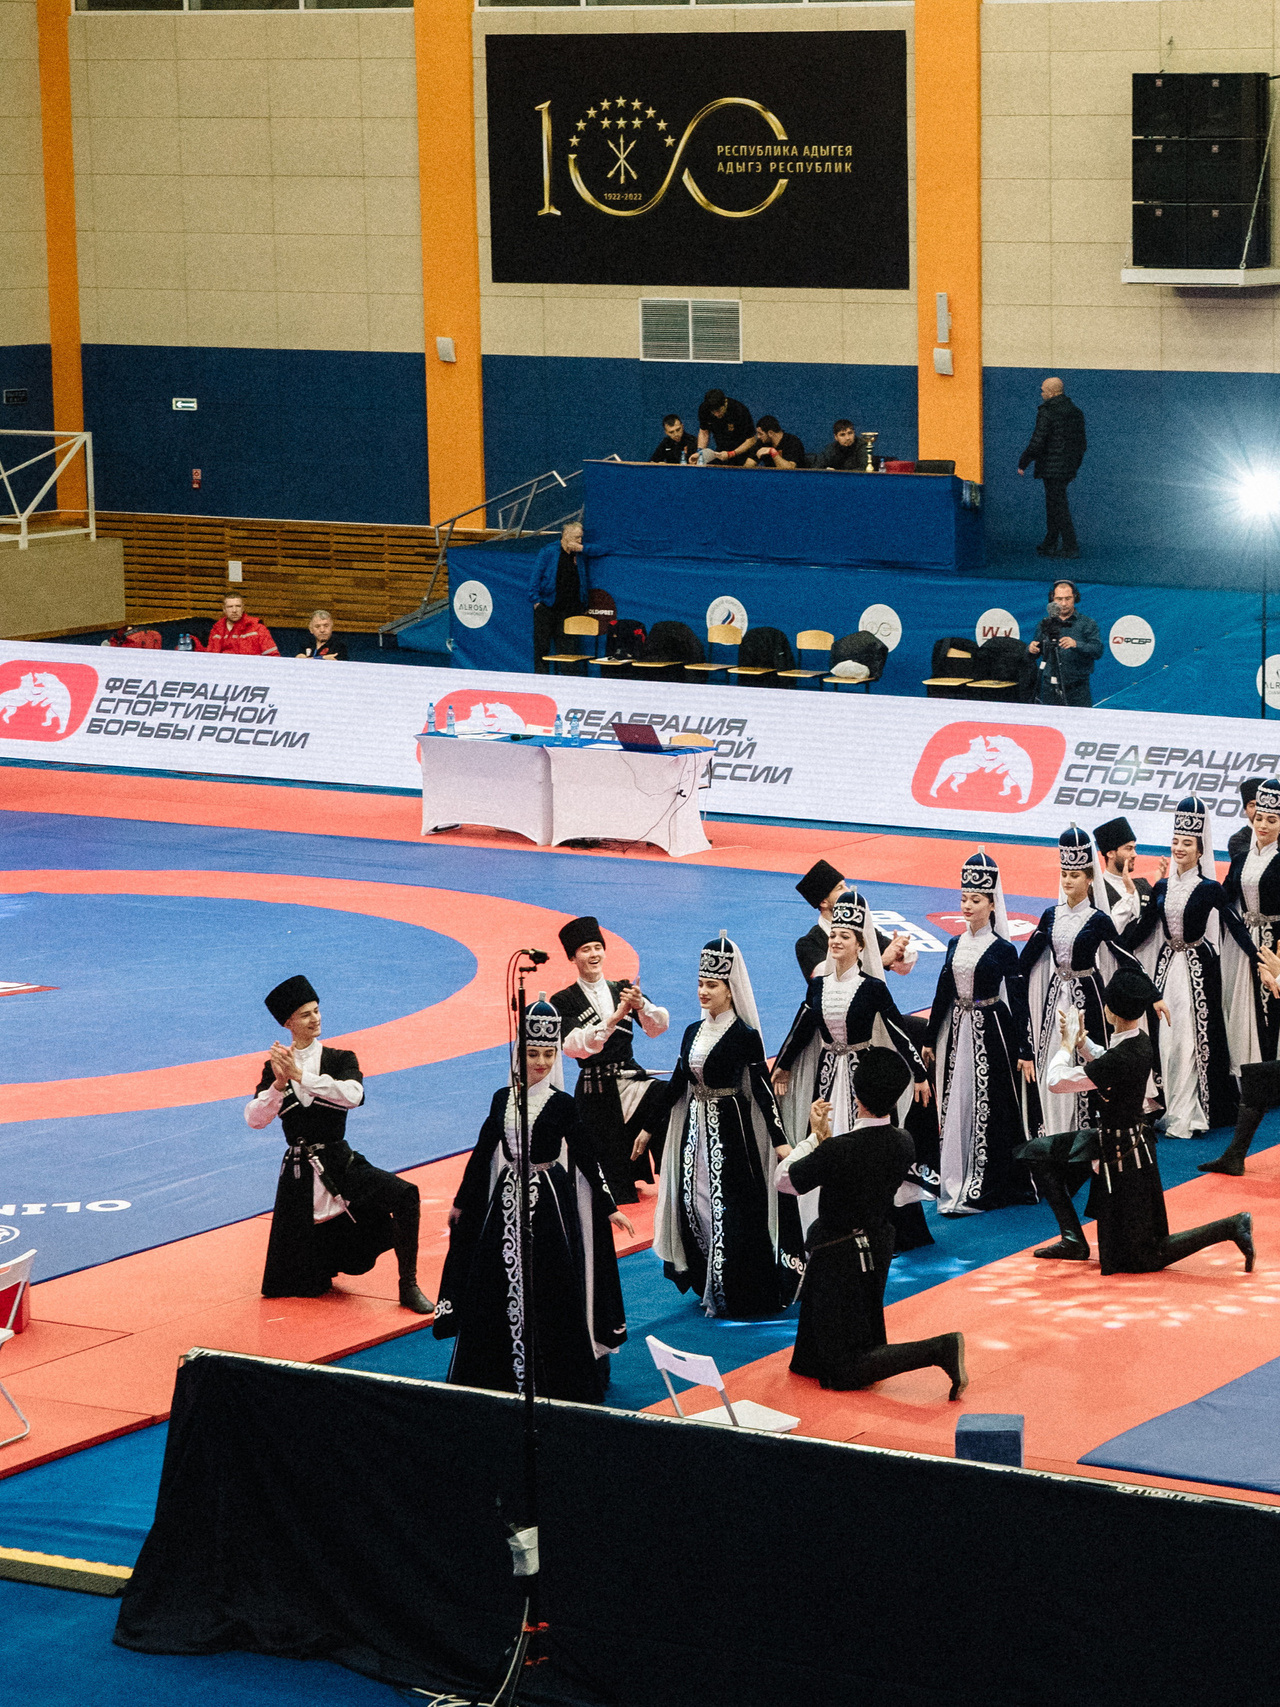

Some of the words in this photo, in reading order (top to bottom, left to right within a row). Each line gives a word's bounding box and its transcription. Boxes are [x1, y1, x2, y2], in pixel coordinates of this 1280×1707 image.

[717, 145, 799, 158] РЕСПУБЛИКА
[803, 145, 853, 158] АДЫГЕЯ
[717, 161, 762, 175] АДЫГЭ
[769, 161, 852, 173] РЕСПУБЛИК
[603, 192, 643, 201] 1922-2022
[1123, 637, 1152, 645] ФСБР
[104, 677, 270, 704] ФЕДЕРАЦИЯ
[95, 697, 278, 725] СПОРТИВНОЙ
[85, 717, 195, 741] БОРЬБЫ
[197, 725, 310, 749] РОССИИ
[1074, 741, 1280, 774] ФЕДЕРАЦИЯ
